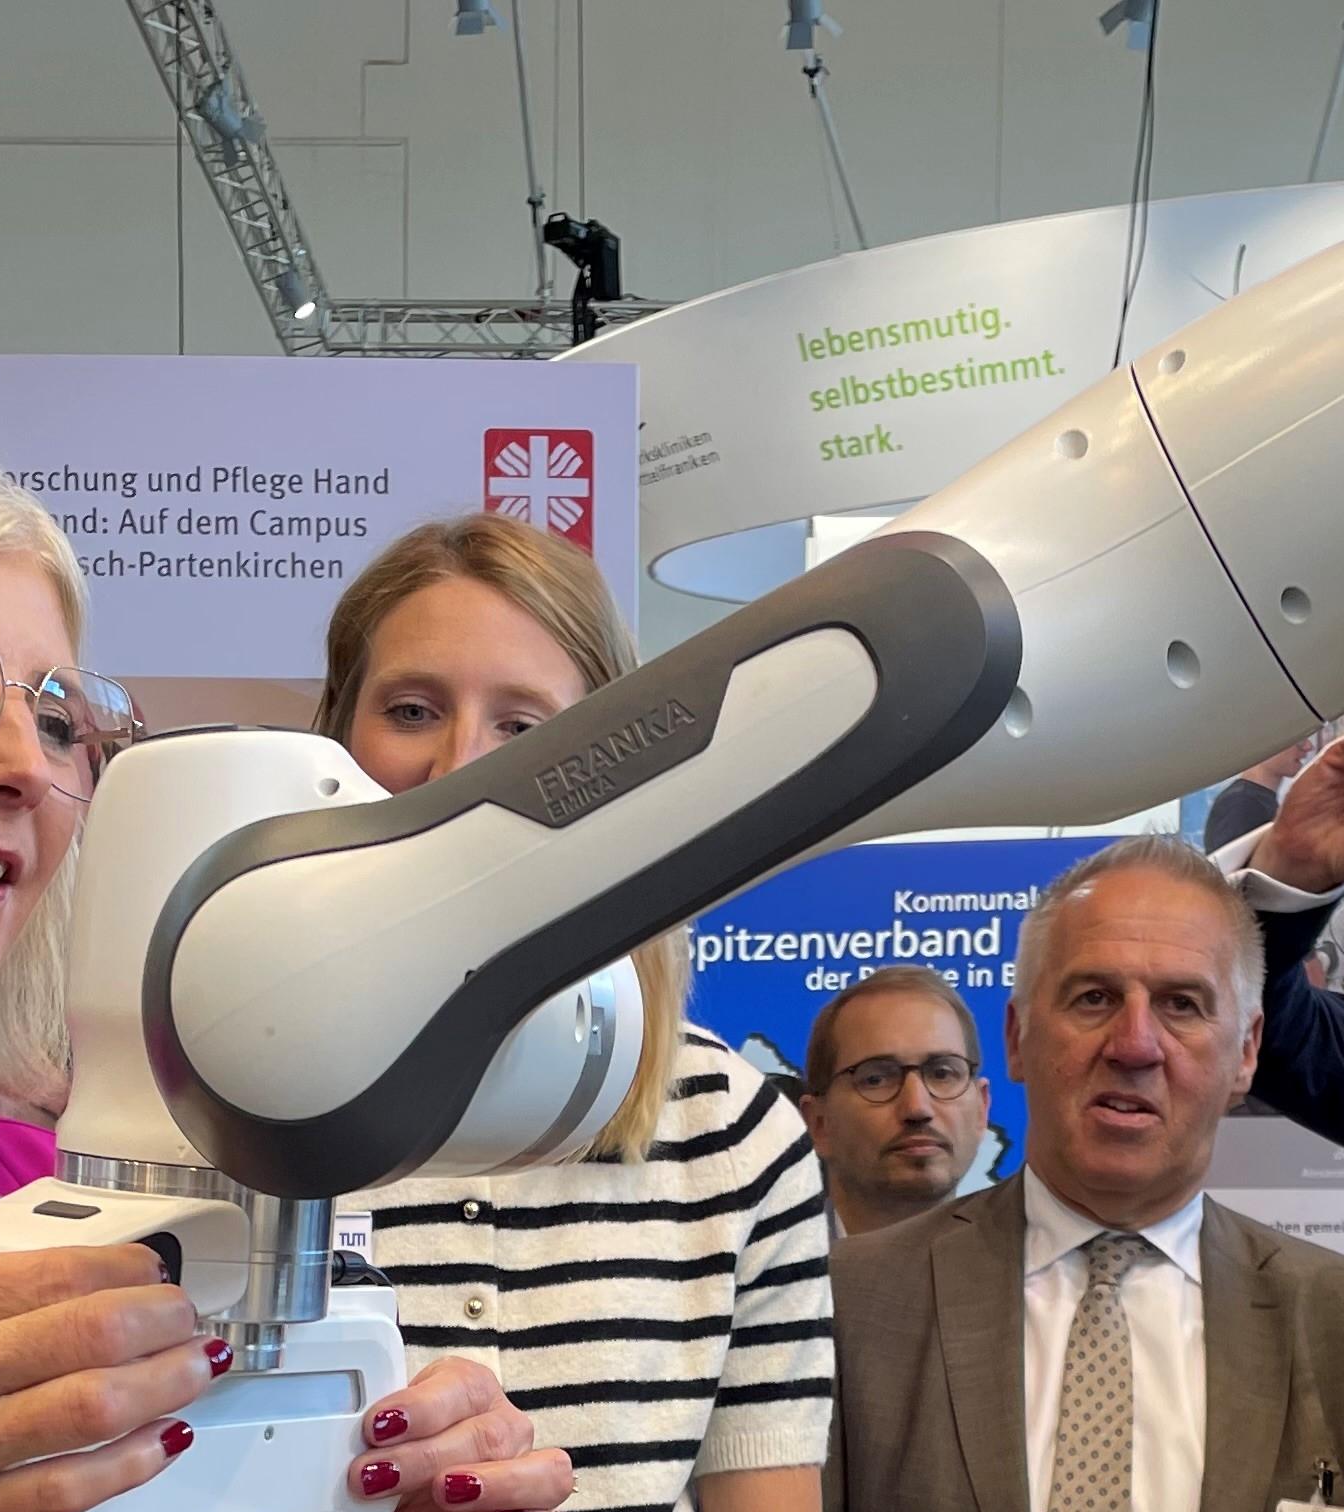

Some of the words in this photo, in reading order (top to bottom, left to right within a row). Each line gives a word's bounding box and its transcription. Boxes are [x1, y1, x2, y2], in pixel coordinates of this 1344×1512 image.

[797, 303, 1011, 362] lebensmutig.
[809, 350, 1065, 412] selbstbestimmt.
[819, 424, 903, 461] stark.
[147, 467, 202, 495] und
[211, 466, 304, 500] Pflege
[313, 467, 390, 496] Hand
[118, 507, 170, 536] Auf
[176, 510, 239, 537] dem
[249, 511, 368, 545] Campus
[535, 698, 695, 803] FRANKA
[544, 774, 617, 823] EMIKA
[805, 966, 852, 991] der
[967, 963, 994, 988] in
[339, 1232, 366, 1247] TUM
